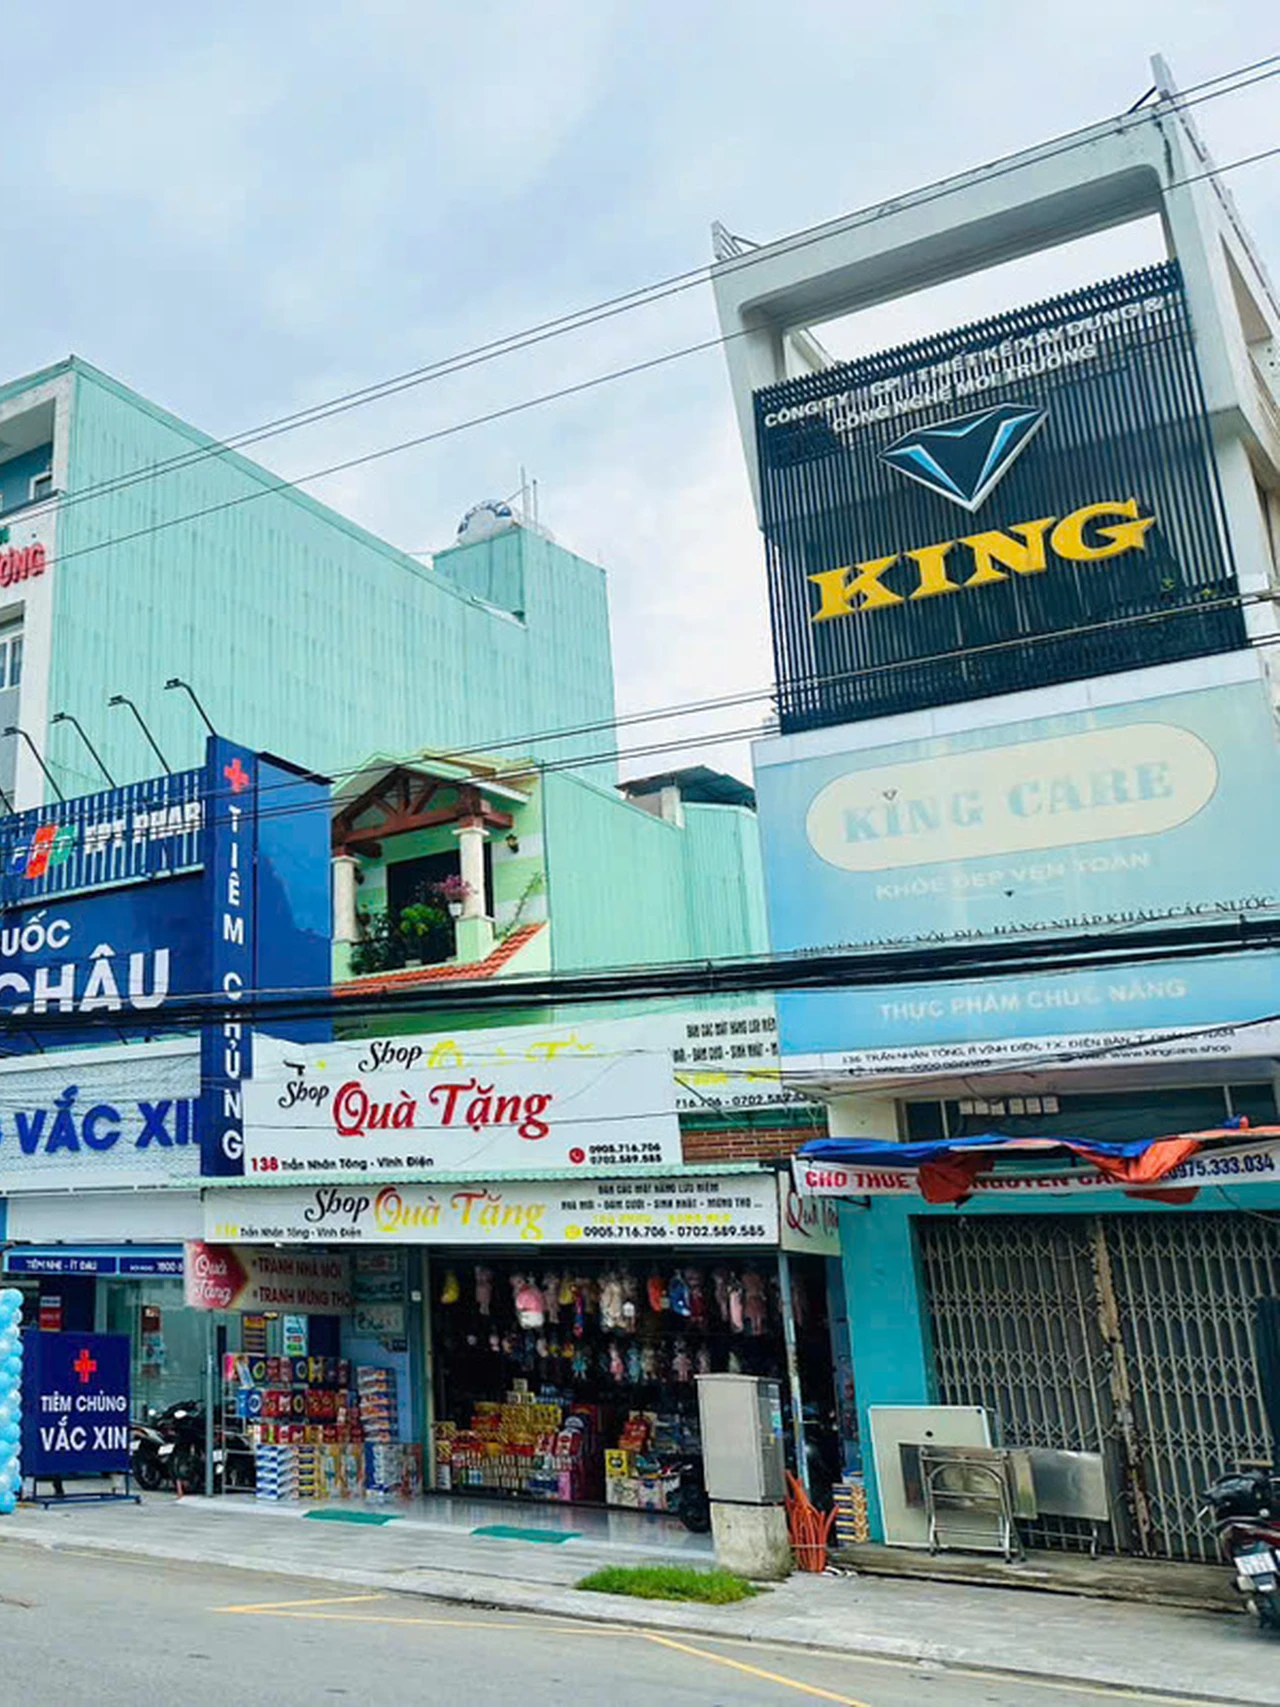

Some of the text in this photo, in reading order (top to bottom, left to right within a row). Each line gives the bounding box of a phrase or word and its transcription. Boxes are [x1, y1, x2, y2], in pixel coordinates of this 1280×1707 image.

[807, 496, 1157, 623] KING
[841, 760, 1176, 844] KING CARE
[132, 800, 204, 844] PHAR
[1169, 901, 1210, 919] CÁC
[1212, 895, 1276, 915] NƯỚC
[220, 804, 245, 1161] TIÊM CHỦNG
[357, 1040, 423, 1073] Shop
[15, 1084, 122, 1155] VẮC
[278, 1077, 553, 1141] Shop Quà Tặng
[251, 1156, 280, 1172] 138
[281, 1156, 305, 1171] Trần
[307, 1155, 337, 1171] Nhân
[339, 1155, 368, 1172] Tông
[406, 1155, 435, 1168] Điện
[805, 1170, 848, 1188] CHO
[1167, 1152, 1276, 1181] 0975.333.034
[303, 1185, 547, 1240] Shop Quà Tặng
[583, 1224, 766, 1238] 0905.716.706 0702.589.585
[195, 1254, 228, 1278] Quà
[258, 1257, 294, 1275] TRANH
[194, 1278, 231, 1304] Tặng
[258, 1286, 295, 1304] TRANH
[41, 1389, 128, 1413] TIÊM CHỦNG
[39, 1416, 128, 1451] VẮC XIN
